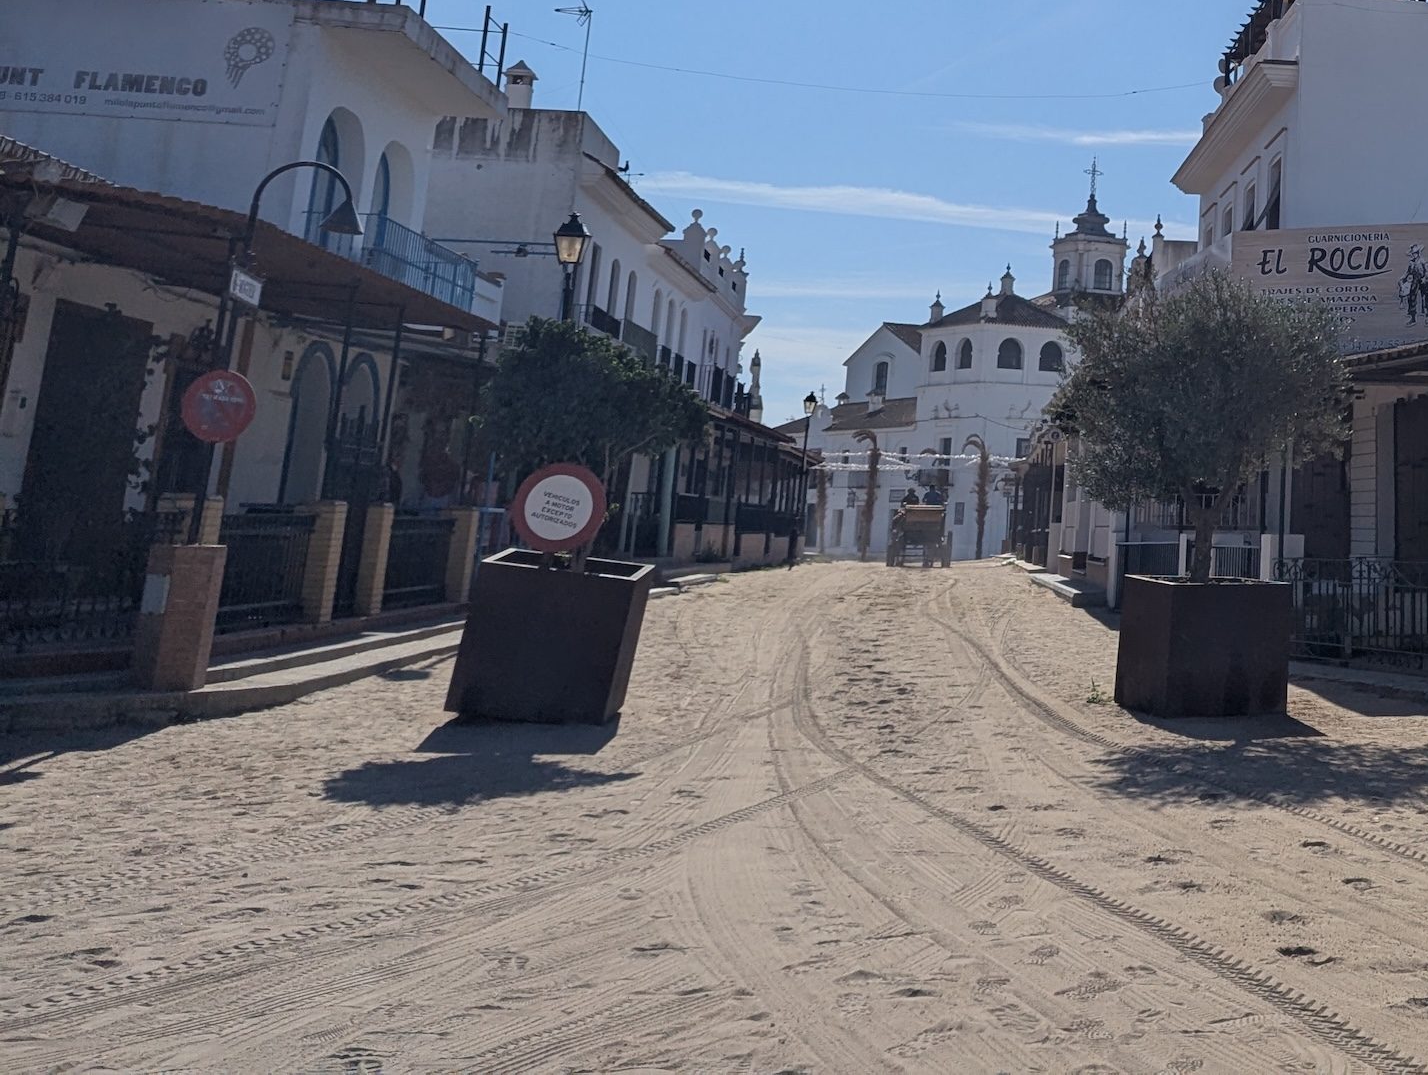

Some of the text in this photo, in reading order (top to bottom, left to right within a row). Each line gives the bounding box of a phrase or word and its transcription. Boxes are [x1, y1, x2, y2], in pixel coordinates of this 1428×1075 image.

[73, 70, 208, 96] FLAMENCO
[1308, 232, 1390, 244] GUARNICIONERIA
[1256, 245, 1392, 280] EL ROCIO
[1261, 287, 1302, 296] TRAJES
[1326, 285, 1369, 294] CORTO
[543, 491, 580, 506] VEHICULOS
[541, 506, 573, 519] EXCEPTO
[552, 501, 575, 512] MOTOR
[531, 511, 577, 529] AUTORIZADOS
